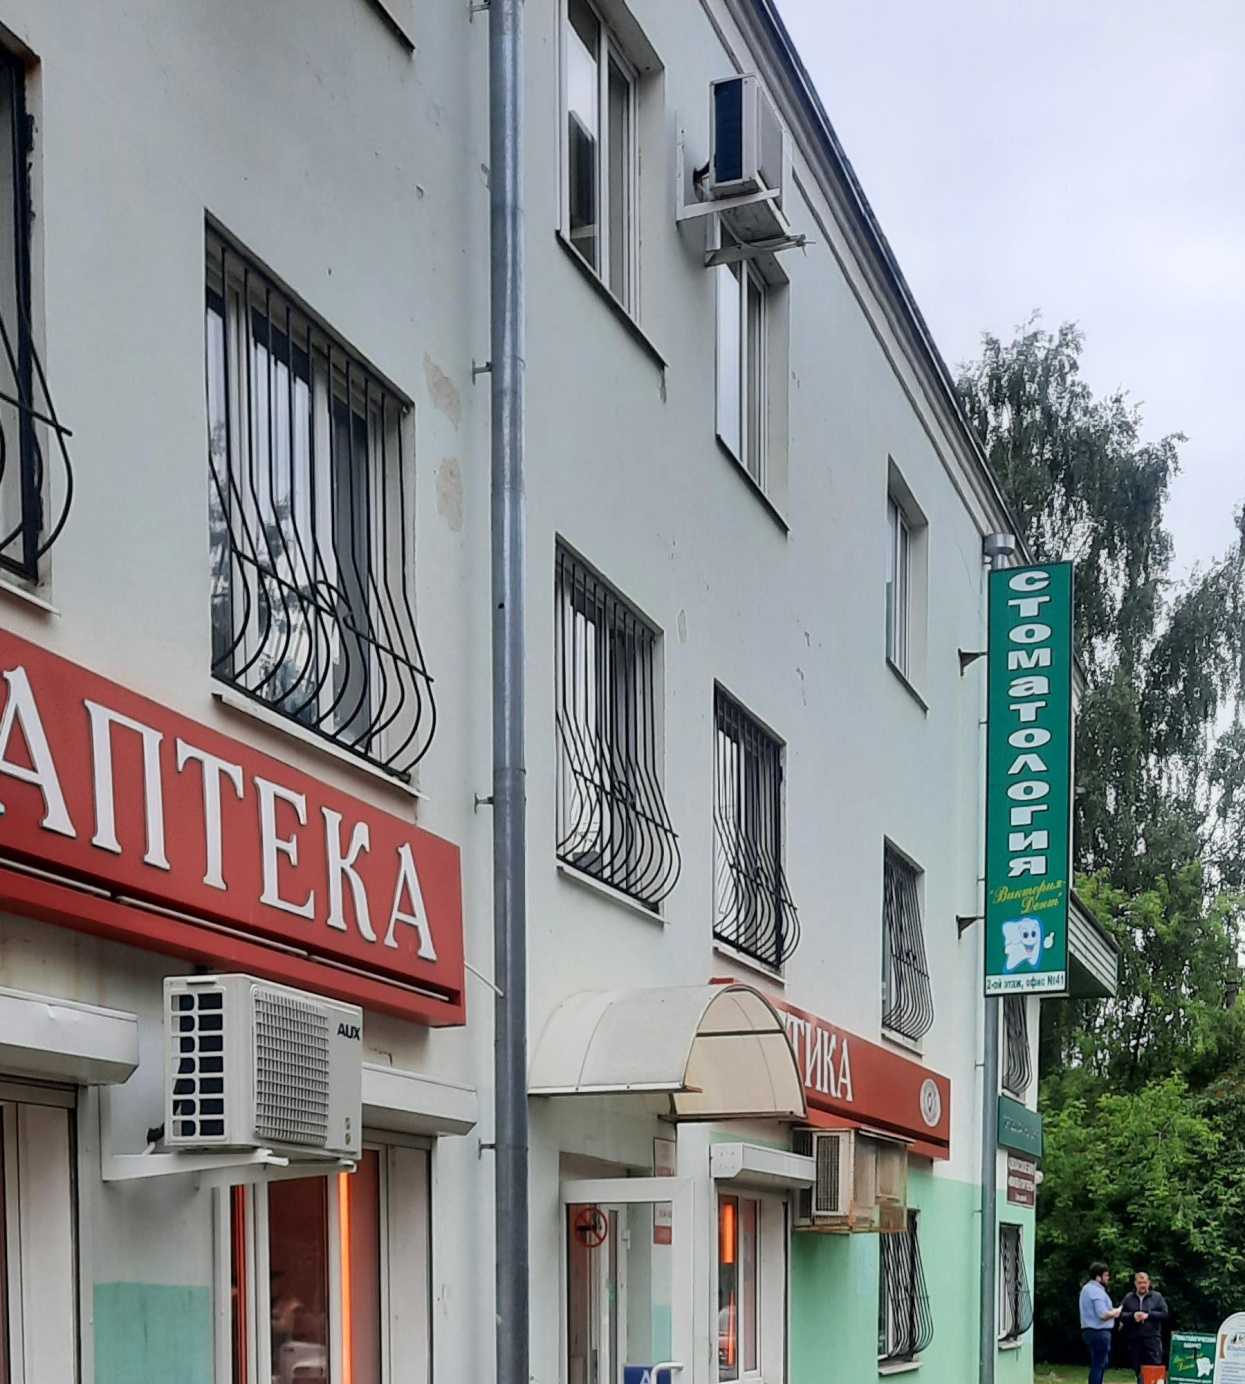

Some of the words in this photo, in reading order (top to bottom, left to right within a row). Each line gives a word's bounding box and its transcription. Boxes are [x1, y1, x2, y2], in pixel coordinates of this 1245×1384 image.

[0, 665, 437, 962] АПТЕКА
[337, 1023, 360, 1041] AUX
[776, 1008, 853, 1102] ТИКА
